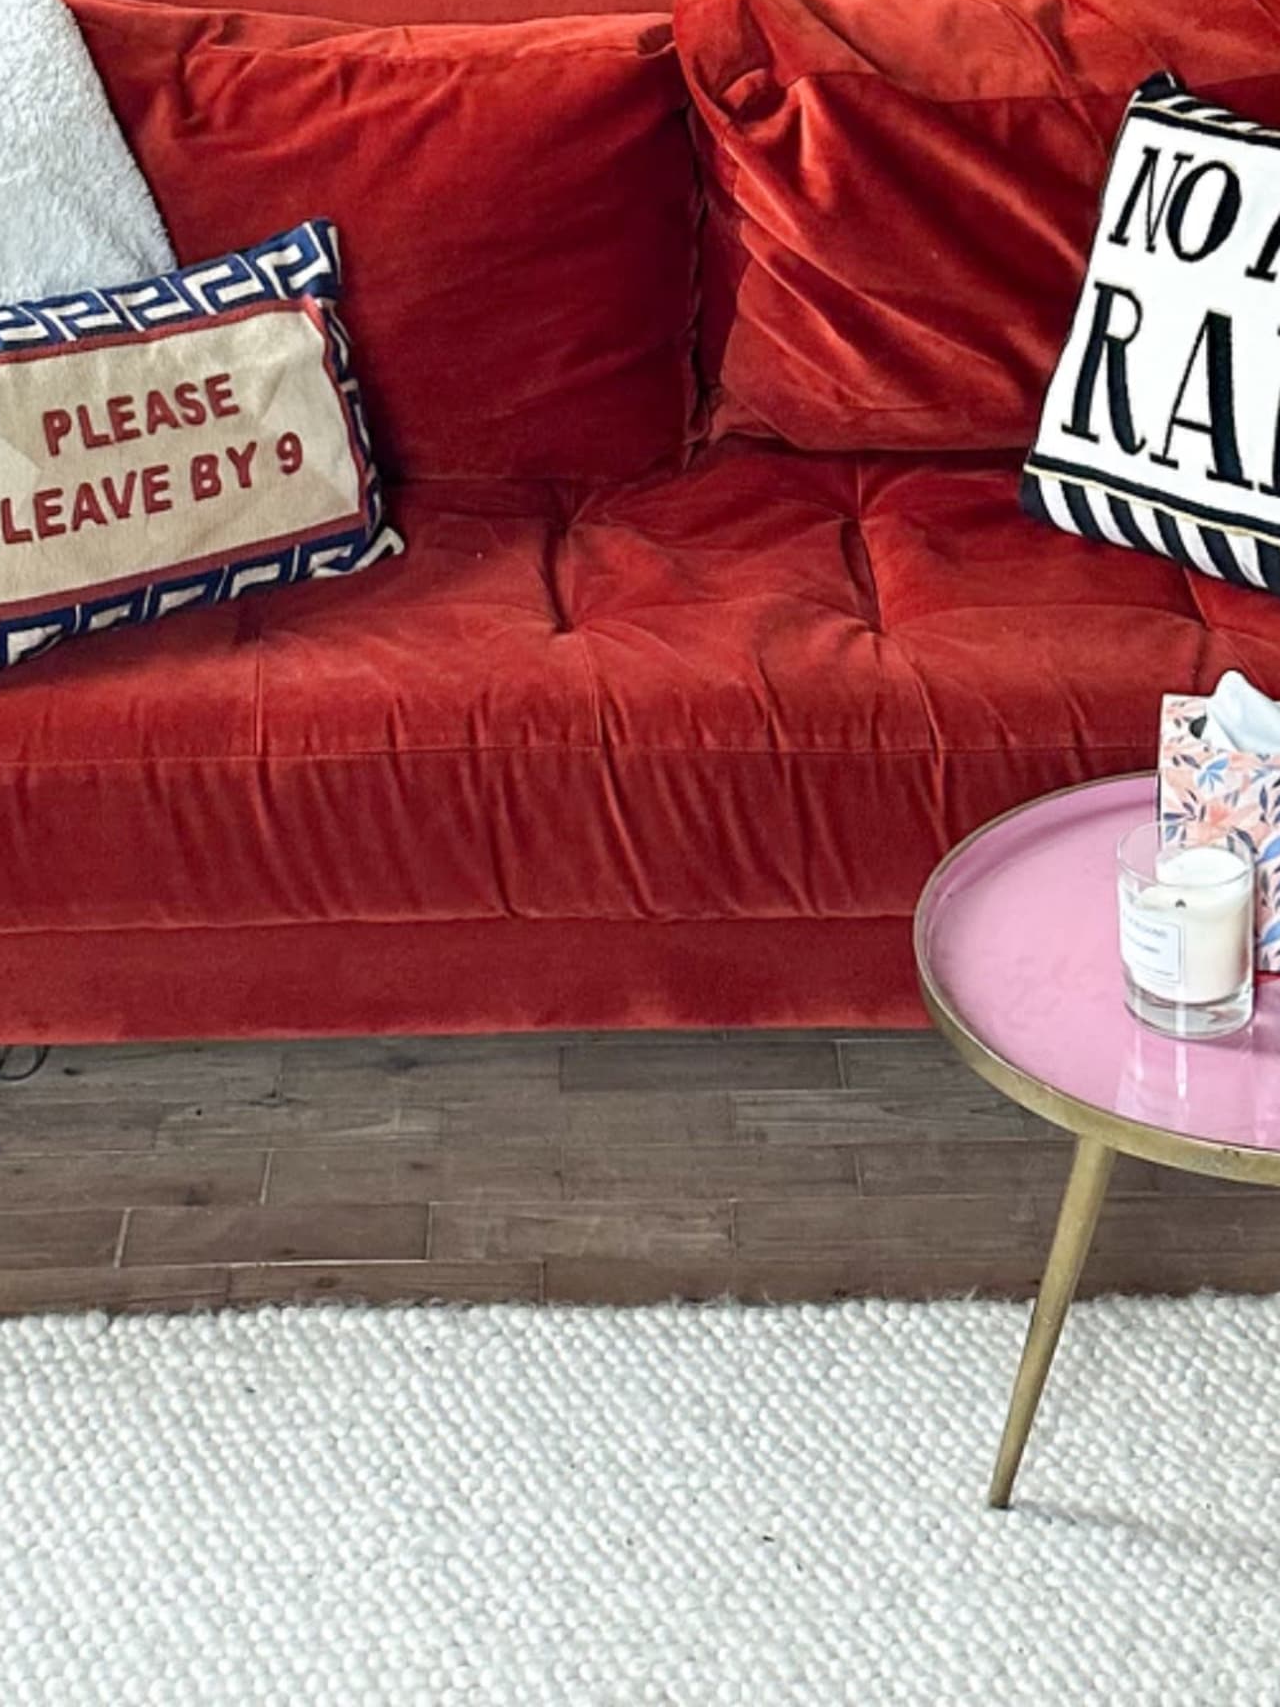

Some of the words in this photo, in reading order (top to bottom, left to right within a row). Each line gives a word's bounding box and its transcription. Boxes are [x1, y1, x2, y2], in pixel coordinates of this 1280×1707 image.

[1108, 146, 1243, 264] NO
[42, 372, 240, 457] PLEASE
[0, 464, 173, 546] LEAVE
[190, 439, 258, 501] BY
[276, 431, 304, 476] 9
